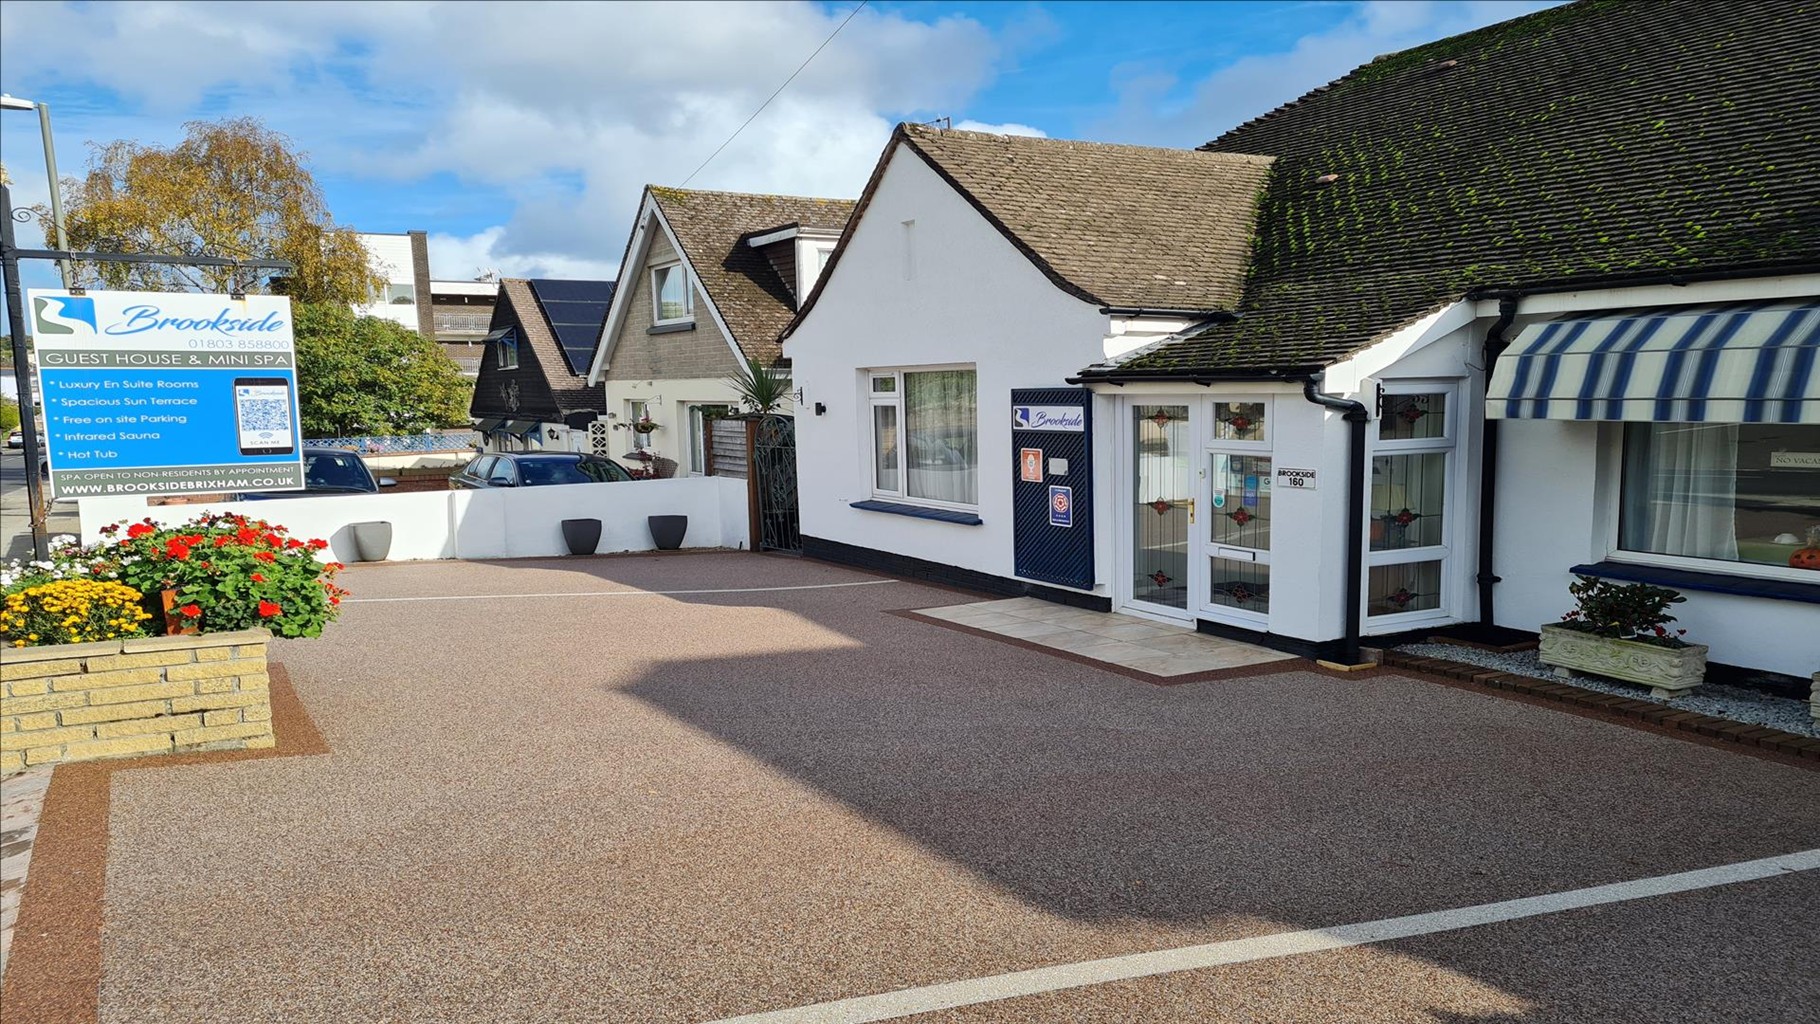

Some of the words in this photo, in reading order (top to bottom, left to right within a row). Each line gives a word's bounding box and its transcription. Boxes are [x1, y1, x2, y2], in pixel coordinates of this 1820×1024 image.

[105, 305, 284, 337] Brookside
[188, 340, 233, 349] 01803
[239, 340, 289, 350] 858800
[46, 354, 108, 364] GUEST
[116, 354, 181, 364] HOUSE
[189, 354, 202, 364] &
[209, 355, 248, 365] MINI
[255, 355, 288, 365] SPA
[59, 380, 100, 390] Luxury
[104, 380, 119, 388] En
[123, 380, 154, 388] Suite
[157, 380, 199, 388] Rooms
[61, 397, 120, 407] Spacious
[124, 397, 147, 405] Sun
[150, 397, 198, 405] Terrace
[63, 415, 91, 424] Free
[116, 415, 137, 423] site
[141, 415, 187, 425] Parking
[1032, 412, 1082, 429] Brookside
[65, 432, 115, 441] Infrared
[119, 432, 160, 440] Sauna
[68, 451, 90, 459] Hot
[94, 450, 117, 459] Tub
[84, 472, 113, 480] OPEN
[134, 470, 211, 479] NON-RESIDENTS
[228, 466, 294, 475] APPOINTMENT
[1278, 470, 1315, 478] BROOKSIDE
[61, 477, 294, 494] WWW.BROOKSIDEBRIXHAM.CO.UK
[1289, 478, 1303, 486] 160
